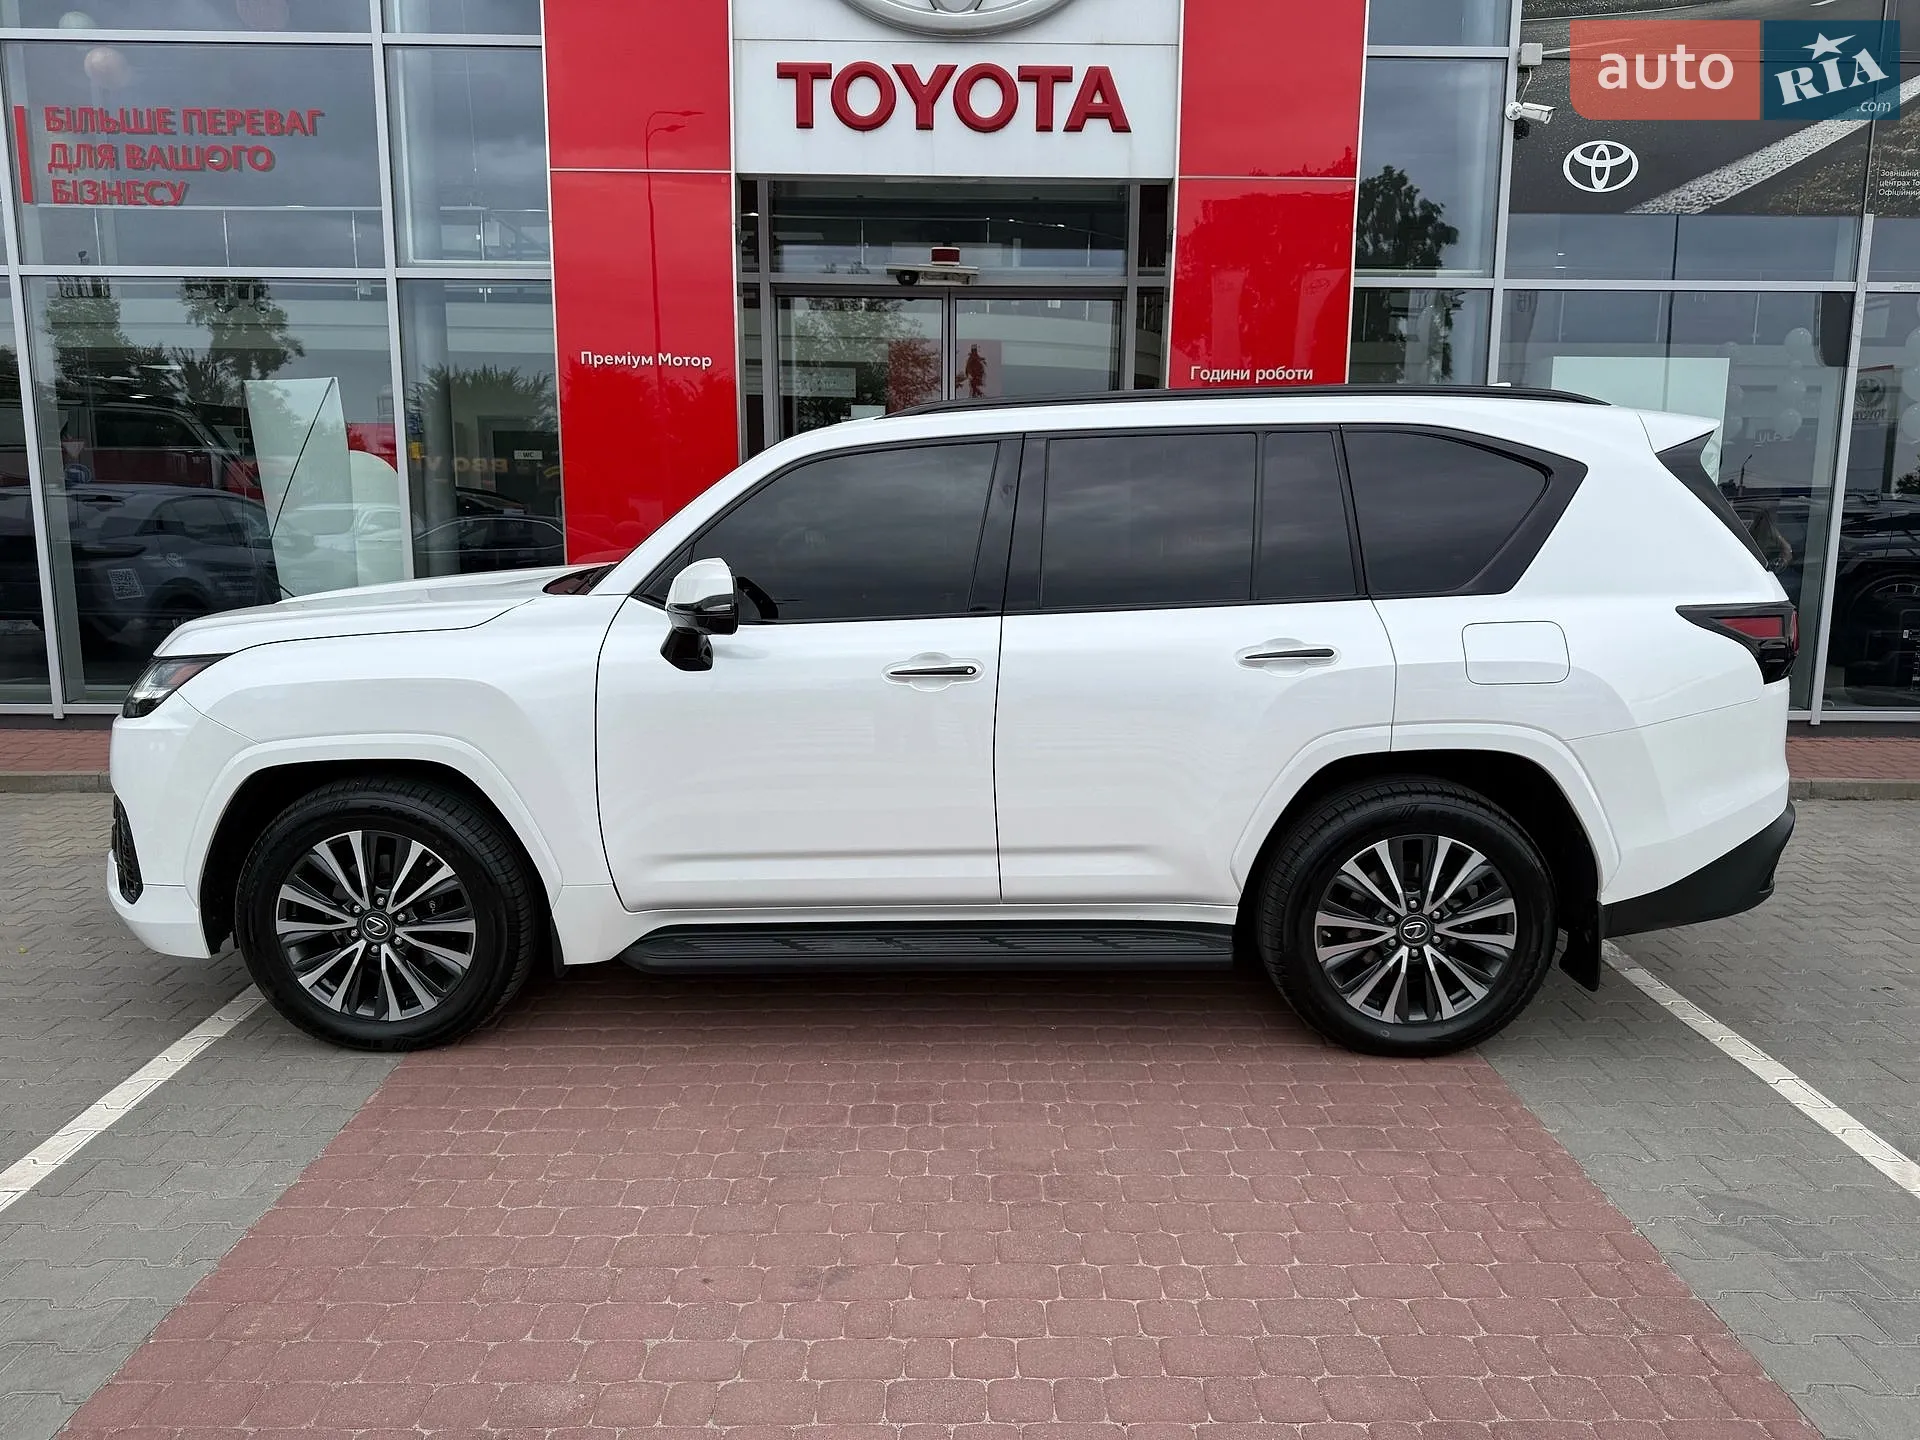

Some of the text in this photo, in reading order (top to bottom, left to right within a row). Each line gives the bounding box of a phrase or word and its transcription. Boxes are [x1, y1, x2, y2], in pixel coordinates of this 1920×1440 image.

[777, 61, 1132, 133] TOYOTA
[44, 106, 324, 136] БІЛЬШЕ ПЕРЕВАГ
[48, 143, 274, 173] ДЛЯ ВАШОГО
[51, 179, 187, 206] БІЗНЕСУ
[581, 351, 713, 370] Преміум Мотор
[1190, 366, 1314, 384] Години роботи
